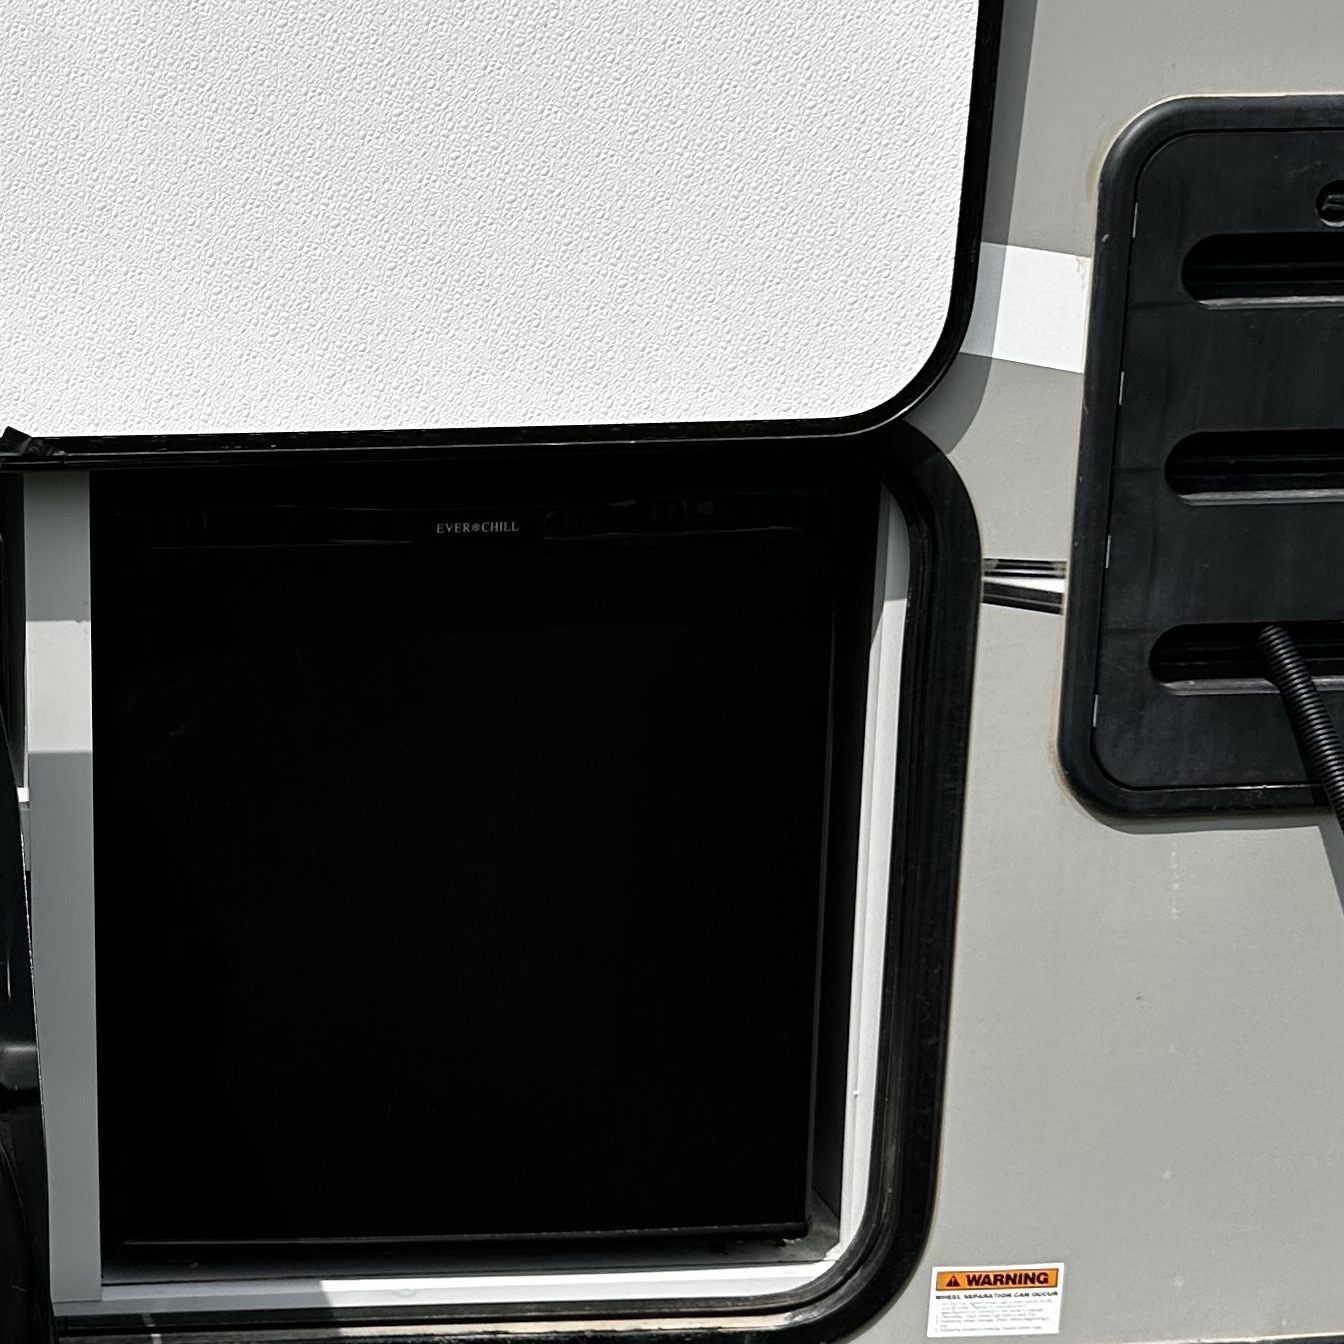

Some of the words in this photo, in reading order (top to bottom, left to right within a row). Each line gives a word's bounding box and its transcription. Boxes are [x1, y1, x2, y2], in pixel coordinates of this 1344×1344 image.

[437, 522, 471, 534] EVER
[481, 521, 520, 533] CHILL
[966, 1272, 1049, 1286] WARNING
